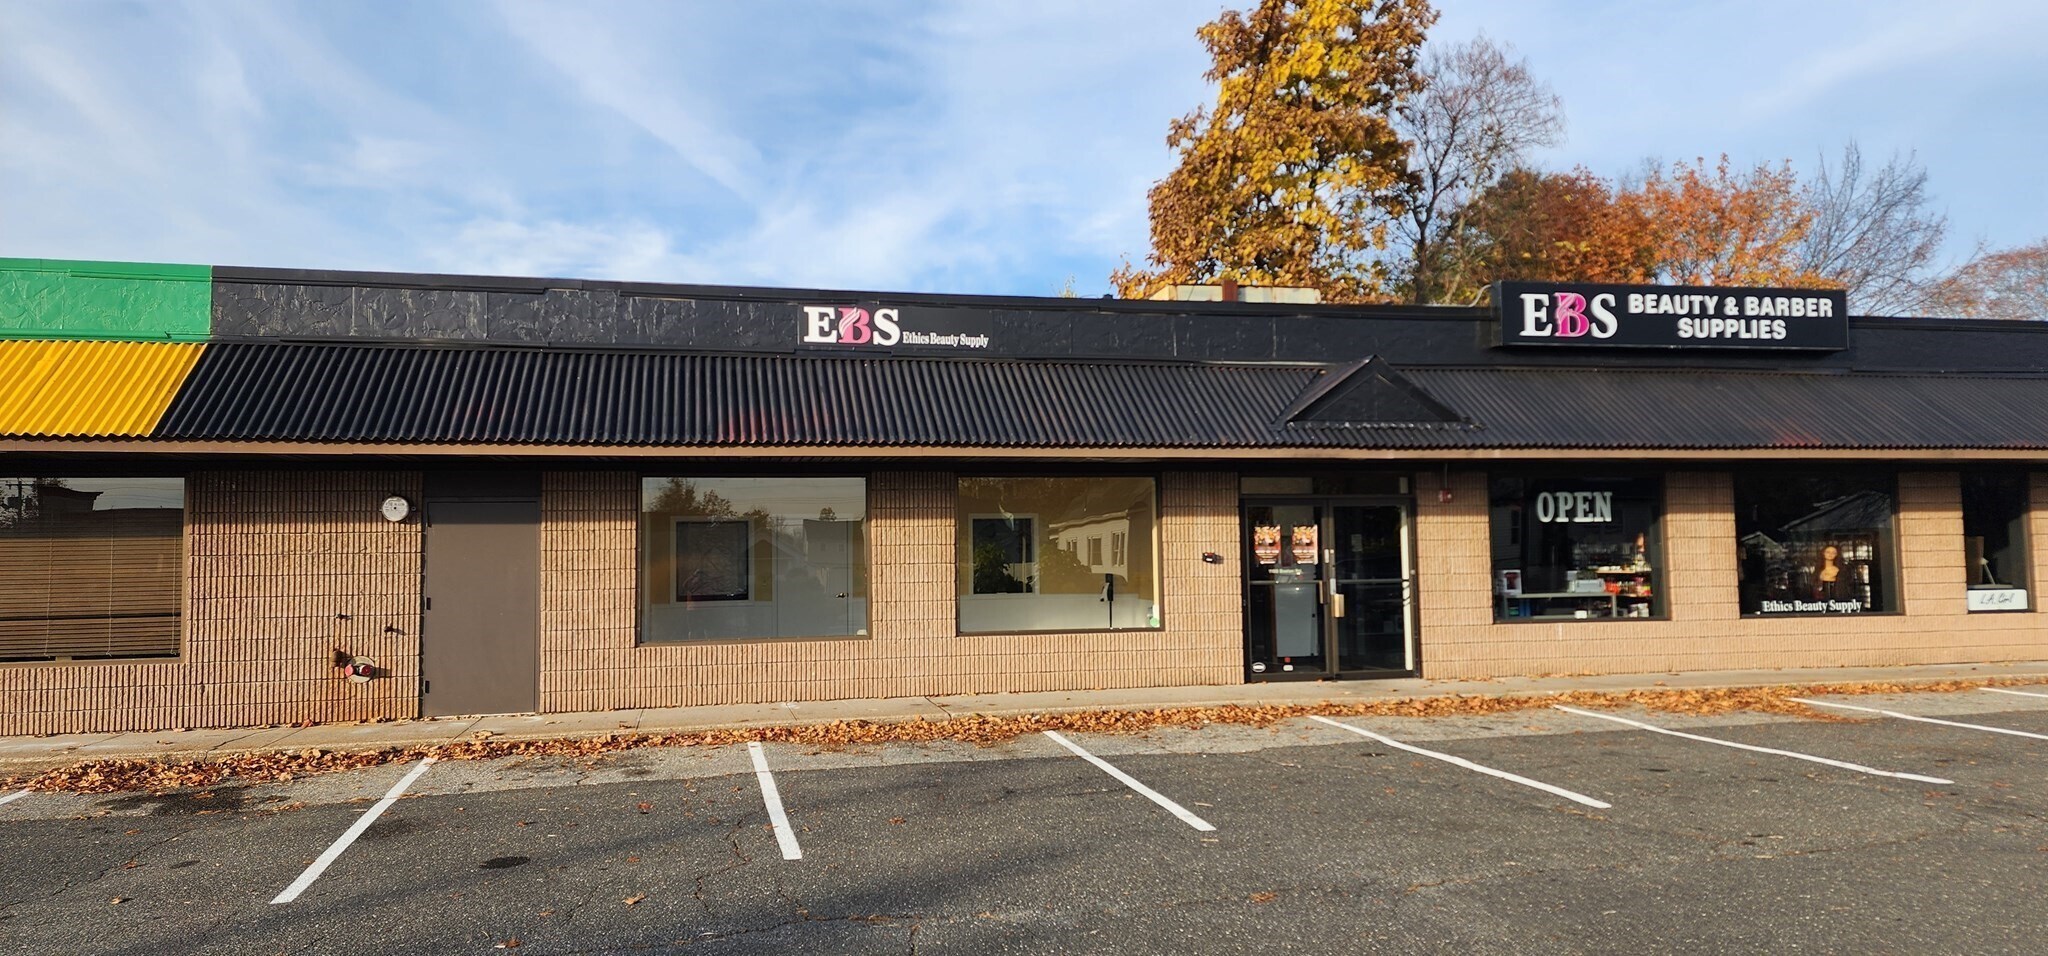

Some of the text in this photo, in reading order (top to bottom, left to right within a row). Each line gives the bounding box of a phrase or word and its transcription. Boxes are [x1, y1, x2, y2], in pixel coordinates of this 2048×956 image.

[1519, 292, 1619, 338] EBS
[1627, 293, 1833, 318] BEAUTY & BARBER
[803, 306, 901, 346] EBS
[1677, 318, 1787, 340] SUPPLIES
[902, 331, 990, 349] Ethics Beauty Supply
[1537, 491, 1613, 523] OPEN
[1761, 598, 1862, 614] Ethics Beauty Supply
